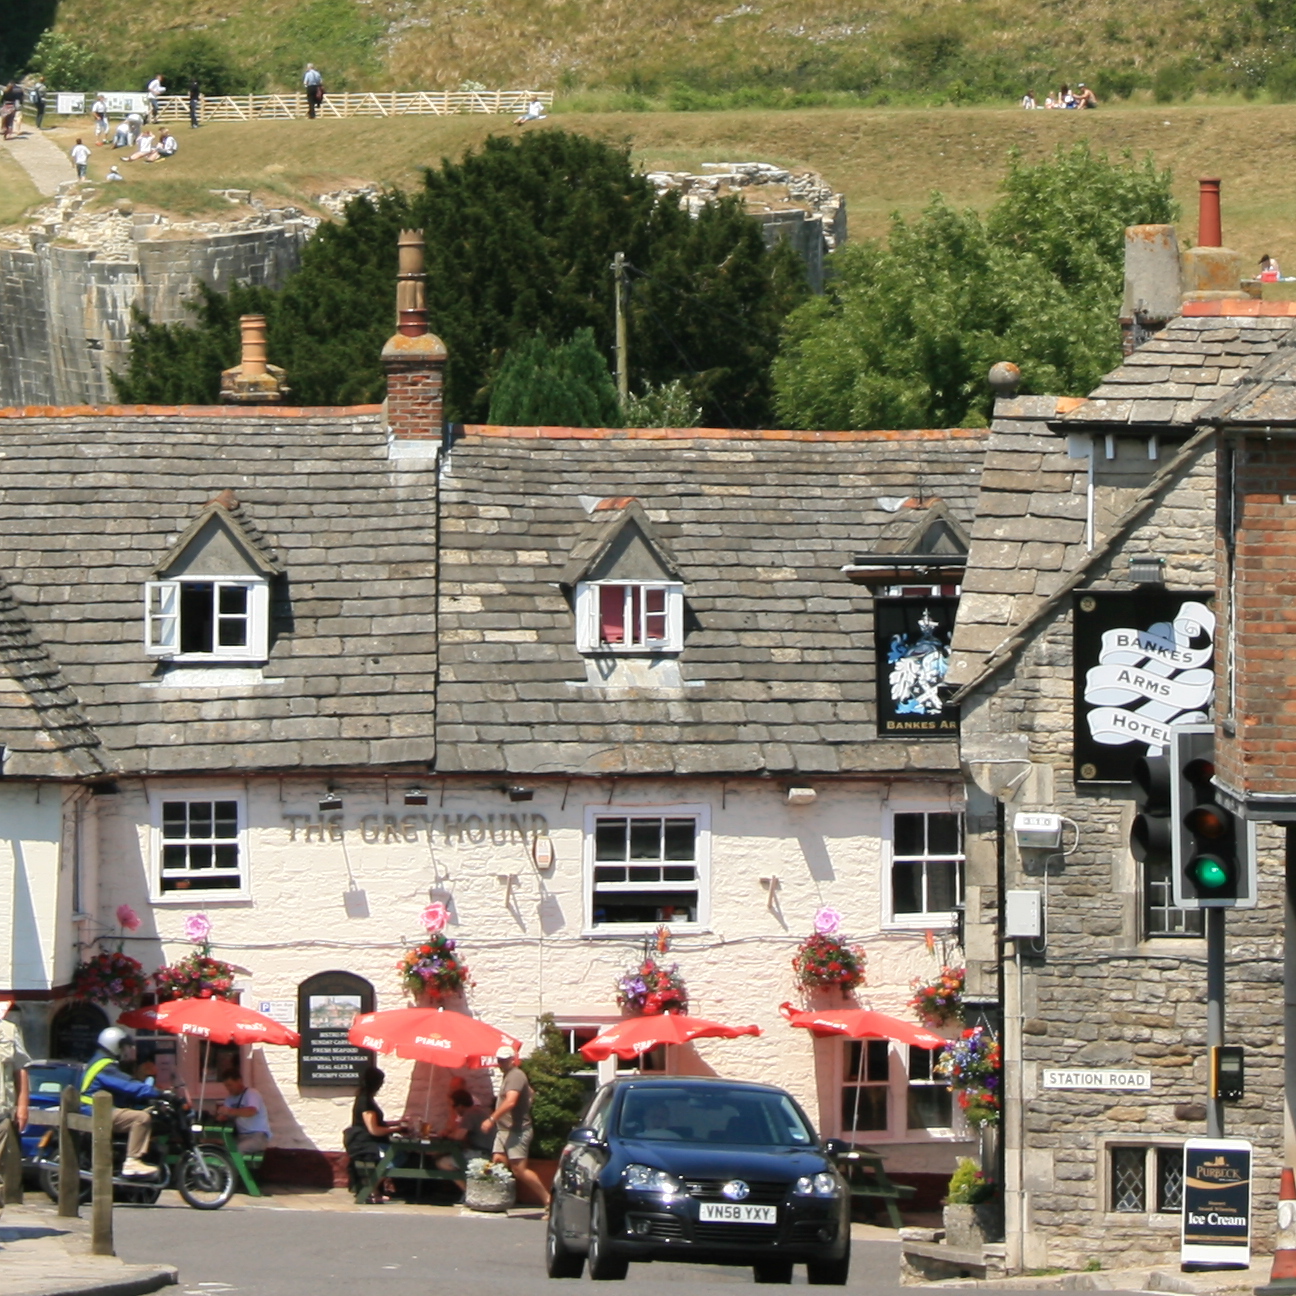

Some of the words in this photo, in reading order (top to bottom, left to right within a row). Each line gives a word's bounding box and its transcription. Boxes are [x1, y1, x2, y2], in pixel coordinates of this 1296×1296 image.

[1117, 635, 1193, 663] BANKES
[1117, 670, 1171, 696] ARMS
[886, 720, 936, 730] BANKES
[940, 720, 957, 729] AR
[1112, 714, 1172, 743] HOTEL
[282, 813, 345, 843] THE
[360, 812, 550, 846] GREYHOUND
[415, 1036, 452, 1049] PIMM'S
[1049, 1072, 1103, 1085] STATION
[1109, 1074, 1145, 1085] ROAD
[1196, 1165, 1242, 1180] PURBECK
[706, 1205, 741, 1219] VN58
[744, 1207, 771, 1220] YXY
[1188, 1212, 1205, 1225] Ice
[1207, 1212, 1246, 1226] Cream
